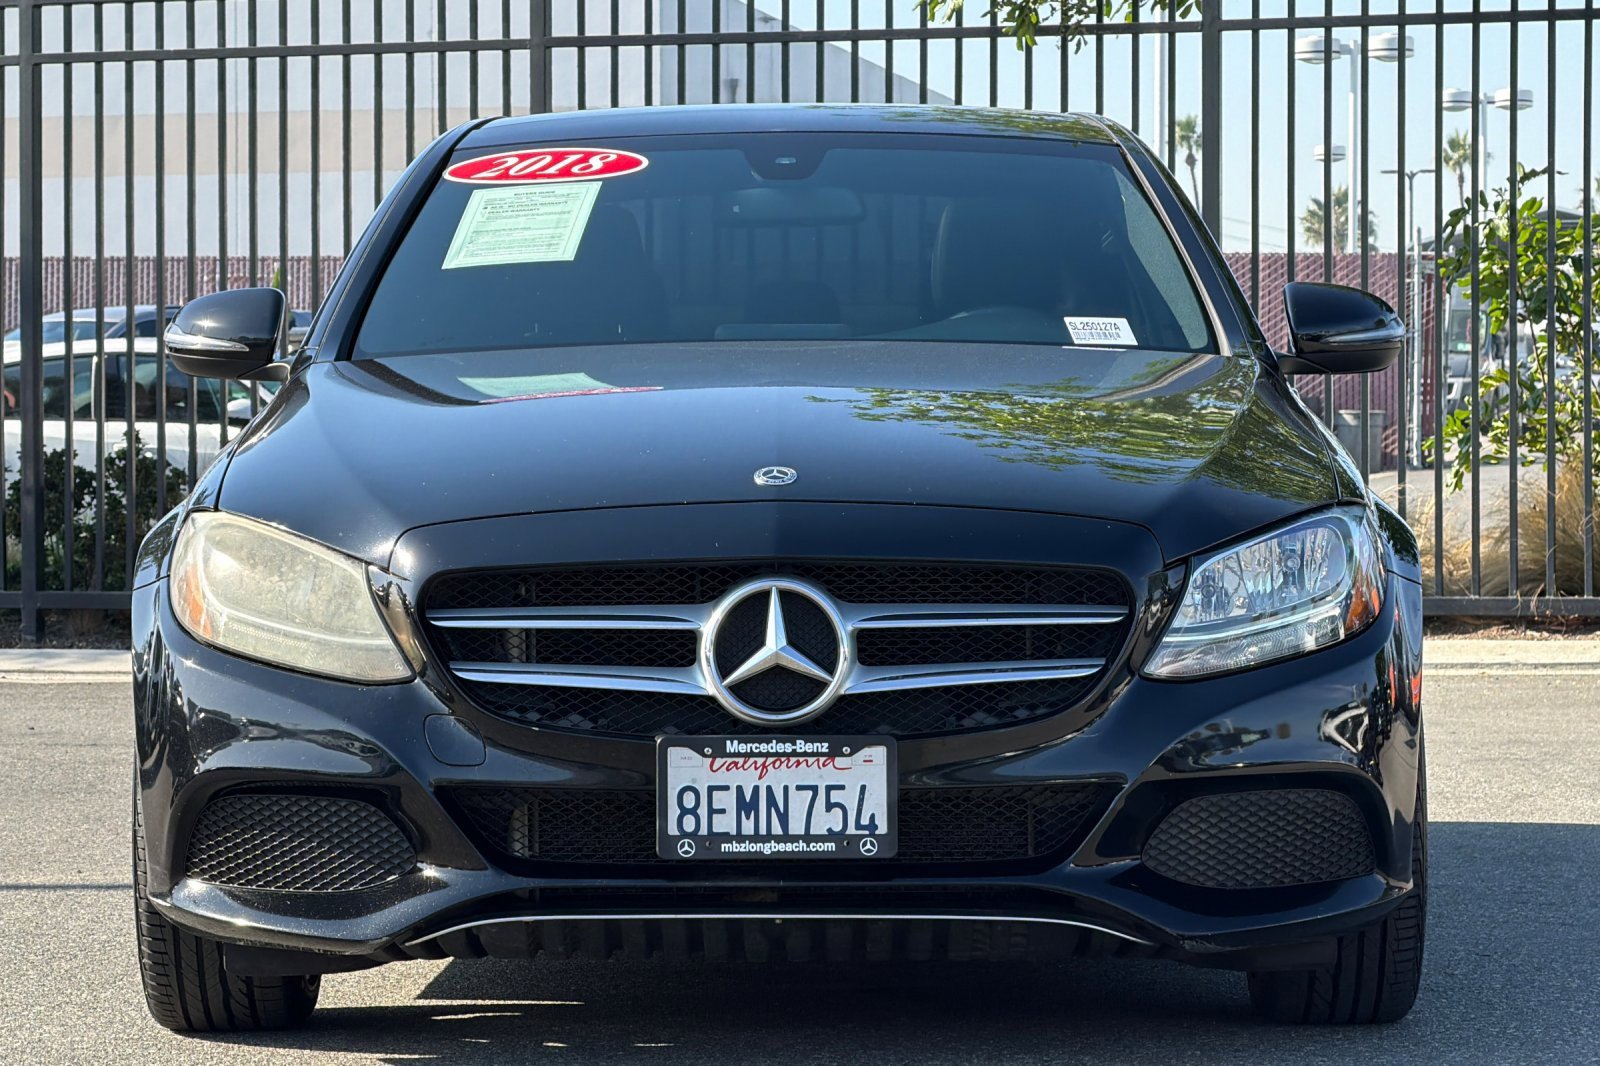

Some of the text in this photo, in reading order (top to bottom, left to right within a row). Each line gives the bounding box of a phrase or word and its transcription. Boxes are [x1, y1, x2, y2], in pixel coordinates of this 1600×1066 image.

[470, 153, 618, 178] 2018
[1069, 321, 1121, 332] SL250127A
[725, 740, 829, 754] Mercedes-Benz
[708, 756, 852, 781] California
[676, 784, 879, 836] 8EMN754
[720, 840, 836, 855] mbzlongbeach.com
